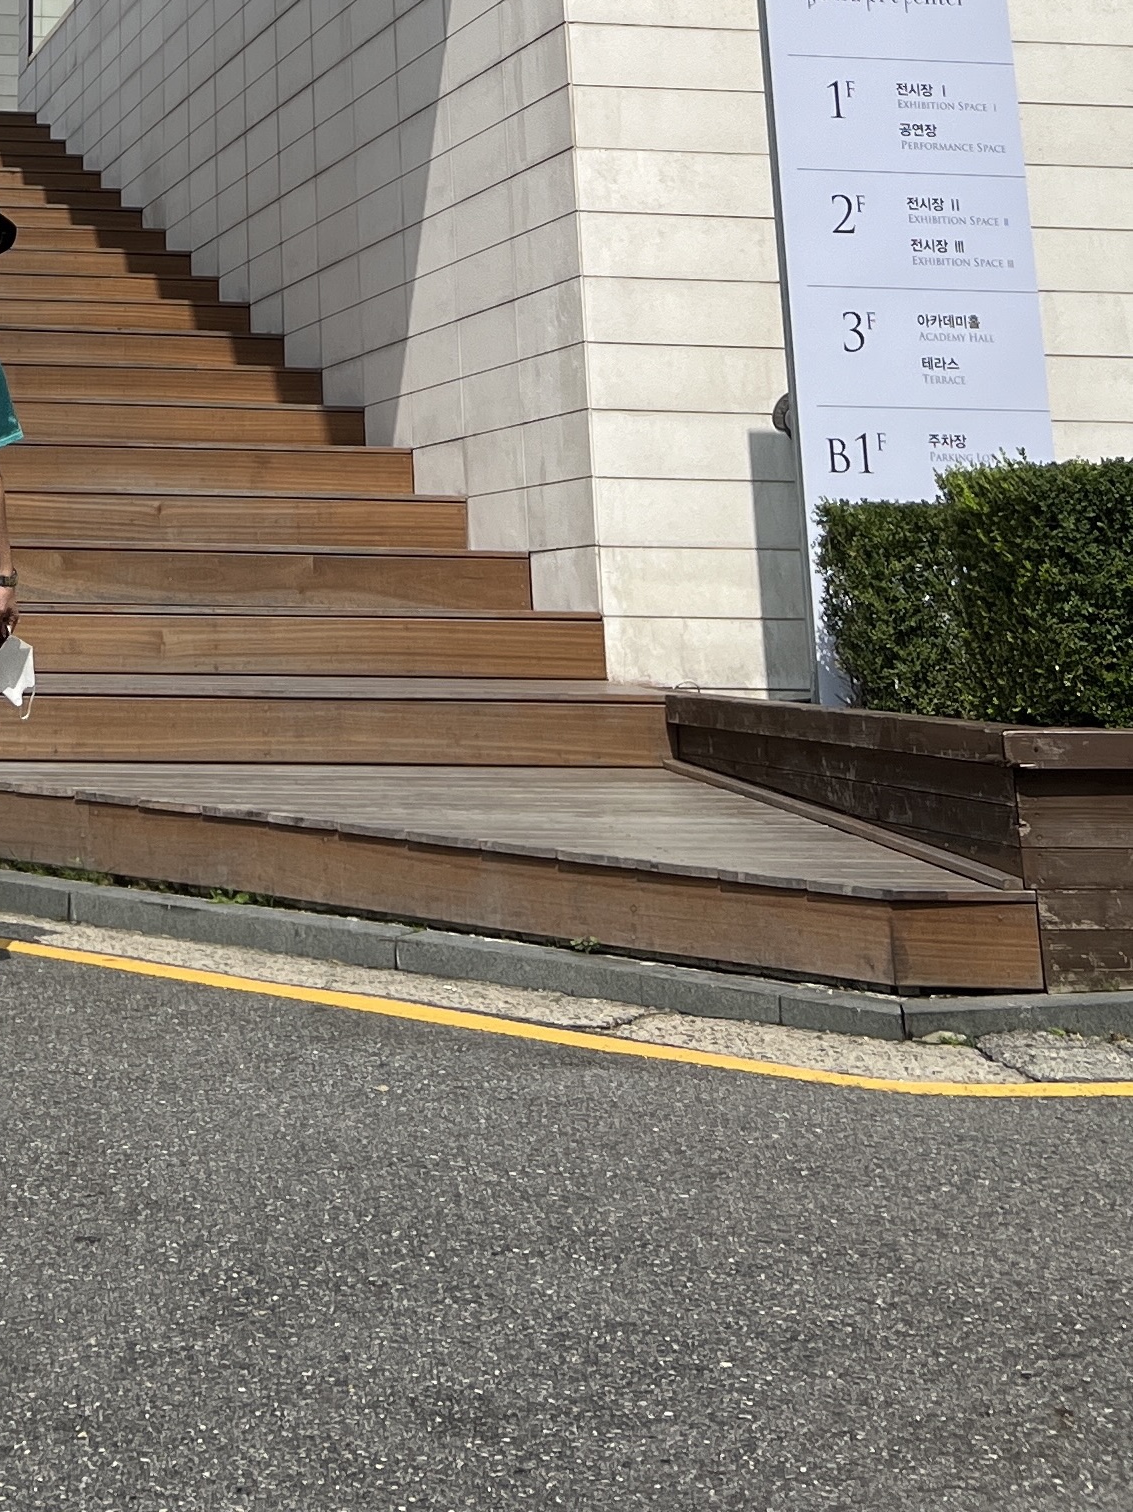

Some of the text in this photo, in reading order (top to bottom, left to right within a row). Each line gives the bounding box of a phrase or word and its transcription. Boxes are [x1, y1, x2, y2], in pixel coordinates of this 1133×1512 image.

[896, 82, 933, 97] 전시장
[897, 99, 955, 111] EXHIBITION
[959, 101, 988, 112] SPACE
[899, 123, 937, 137] 공연장
[901, 140, 1006, 154] PERFORMANCE SPACE
[906, 197, 944, 212] 전시장
[908, 214, 967, 225] EXHIBITION
[969, 216, 999, 227] SPACE
[910, 238, 948, 253] 전시장
[912, 256, 971, 267] EXHIBITION
[973, 257, 1003, 268] SPACE
[917, 313, 980, 329] 아카데미홀
[919, 331, 995, 343] ACADEMY HALL
[921, 356, 960, 371] 테라스
[922, 374, 966, 385] TERRACE
[928, 433, 967, 449] 주차장
[929, 451, 973, 463] PARKING
